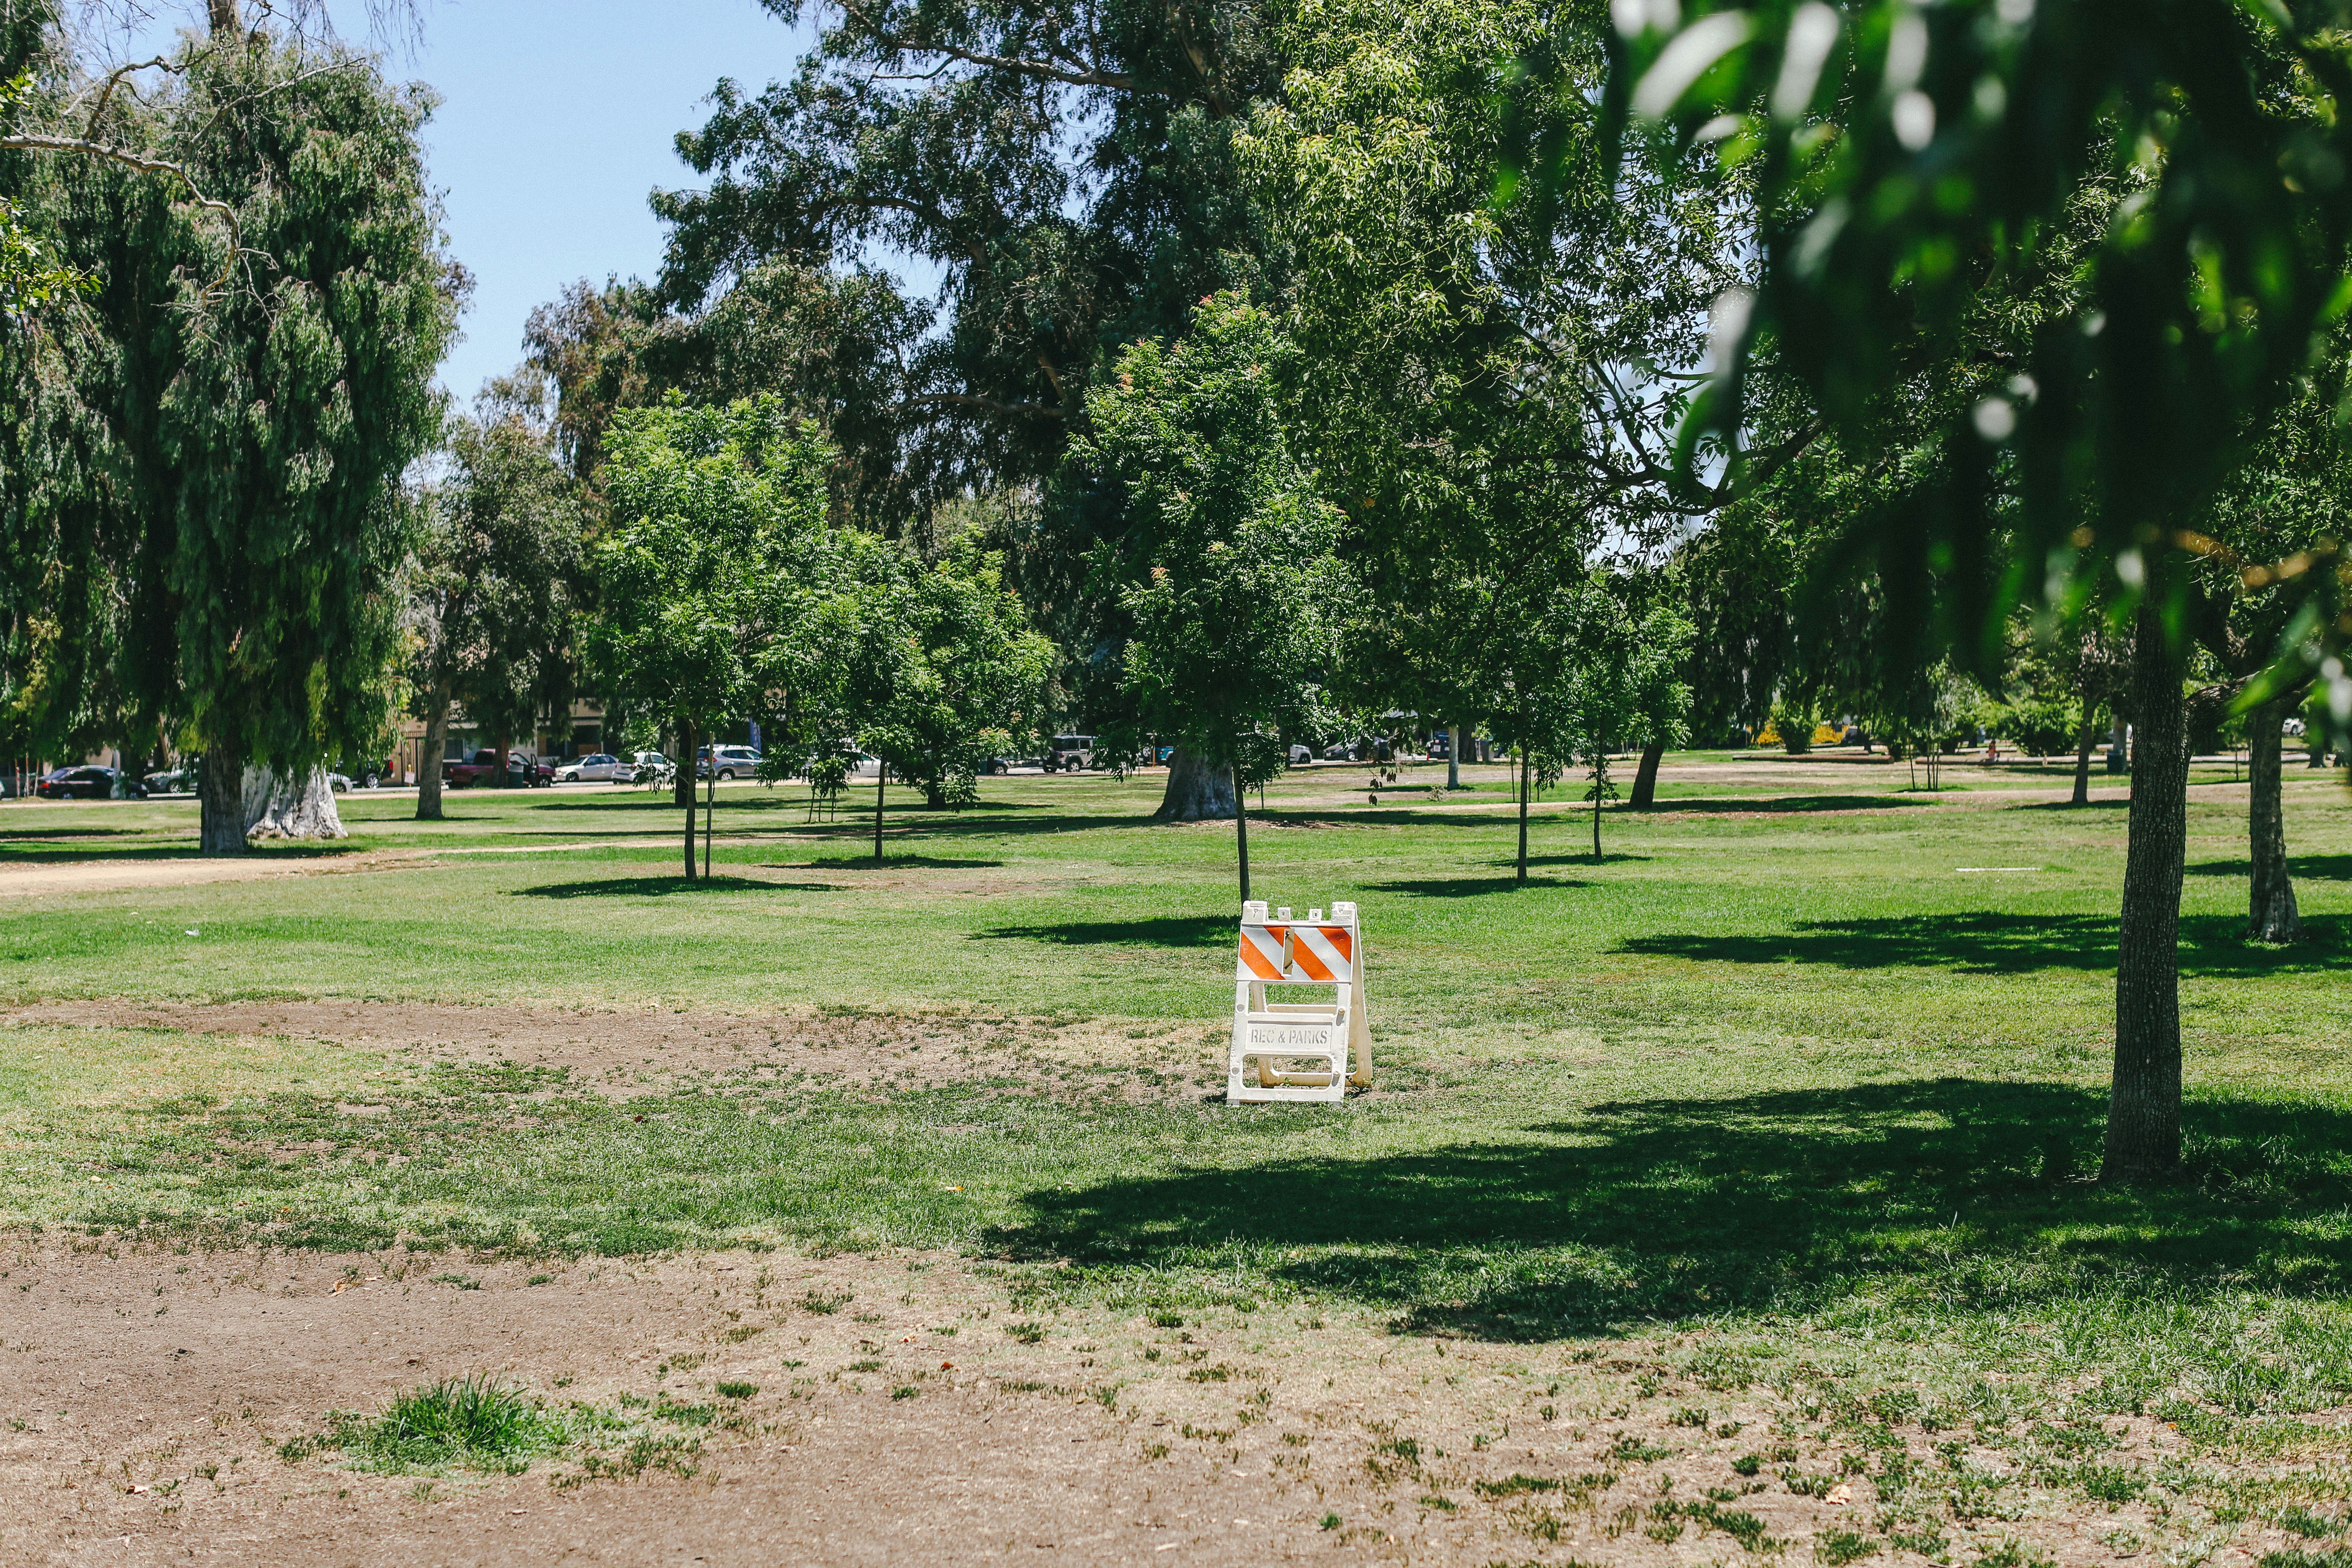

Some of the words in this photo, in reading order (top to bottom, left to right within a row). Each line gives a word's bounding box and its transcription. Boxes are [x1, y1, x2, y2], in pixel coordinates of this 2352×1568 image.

[1251, 1029, 1275, 1043] REC
[1278, 1030, 1285, 1044] &
[1289, 1030, 1327, 1044] PARKS
